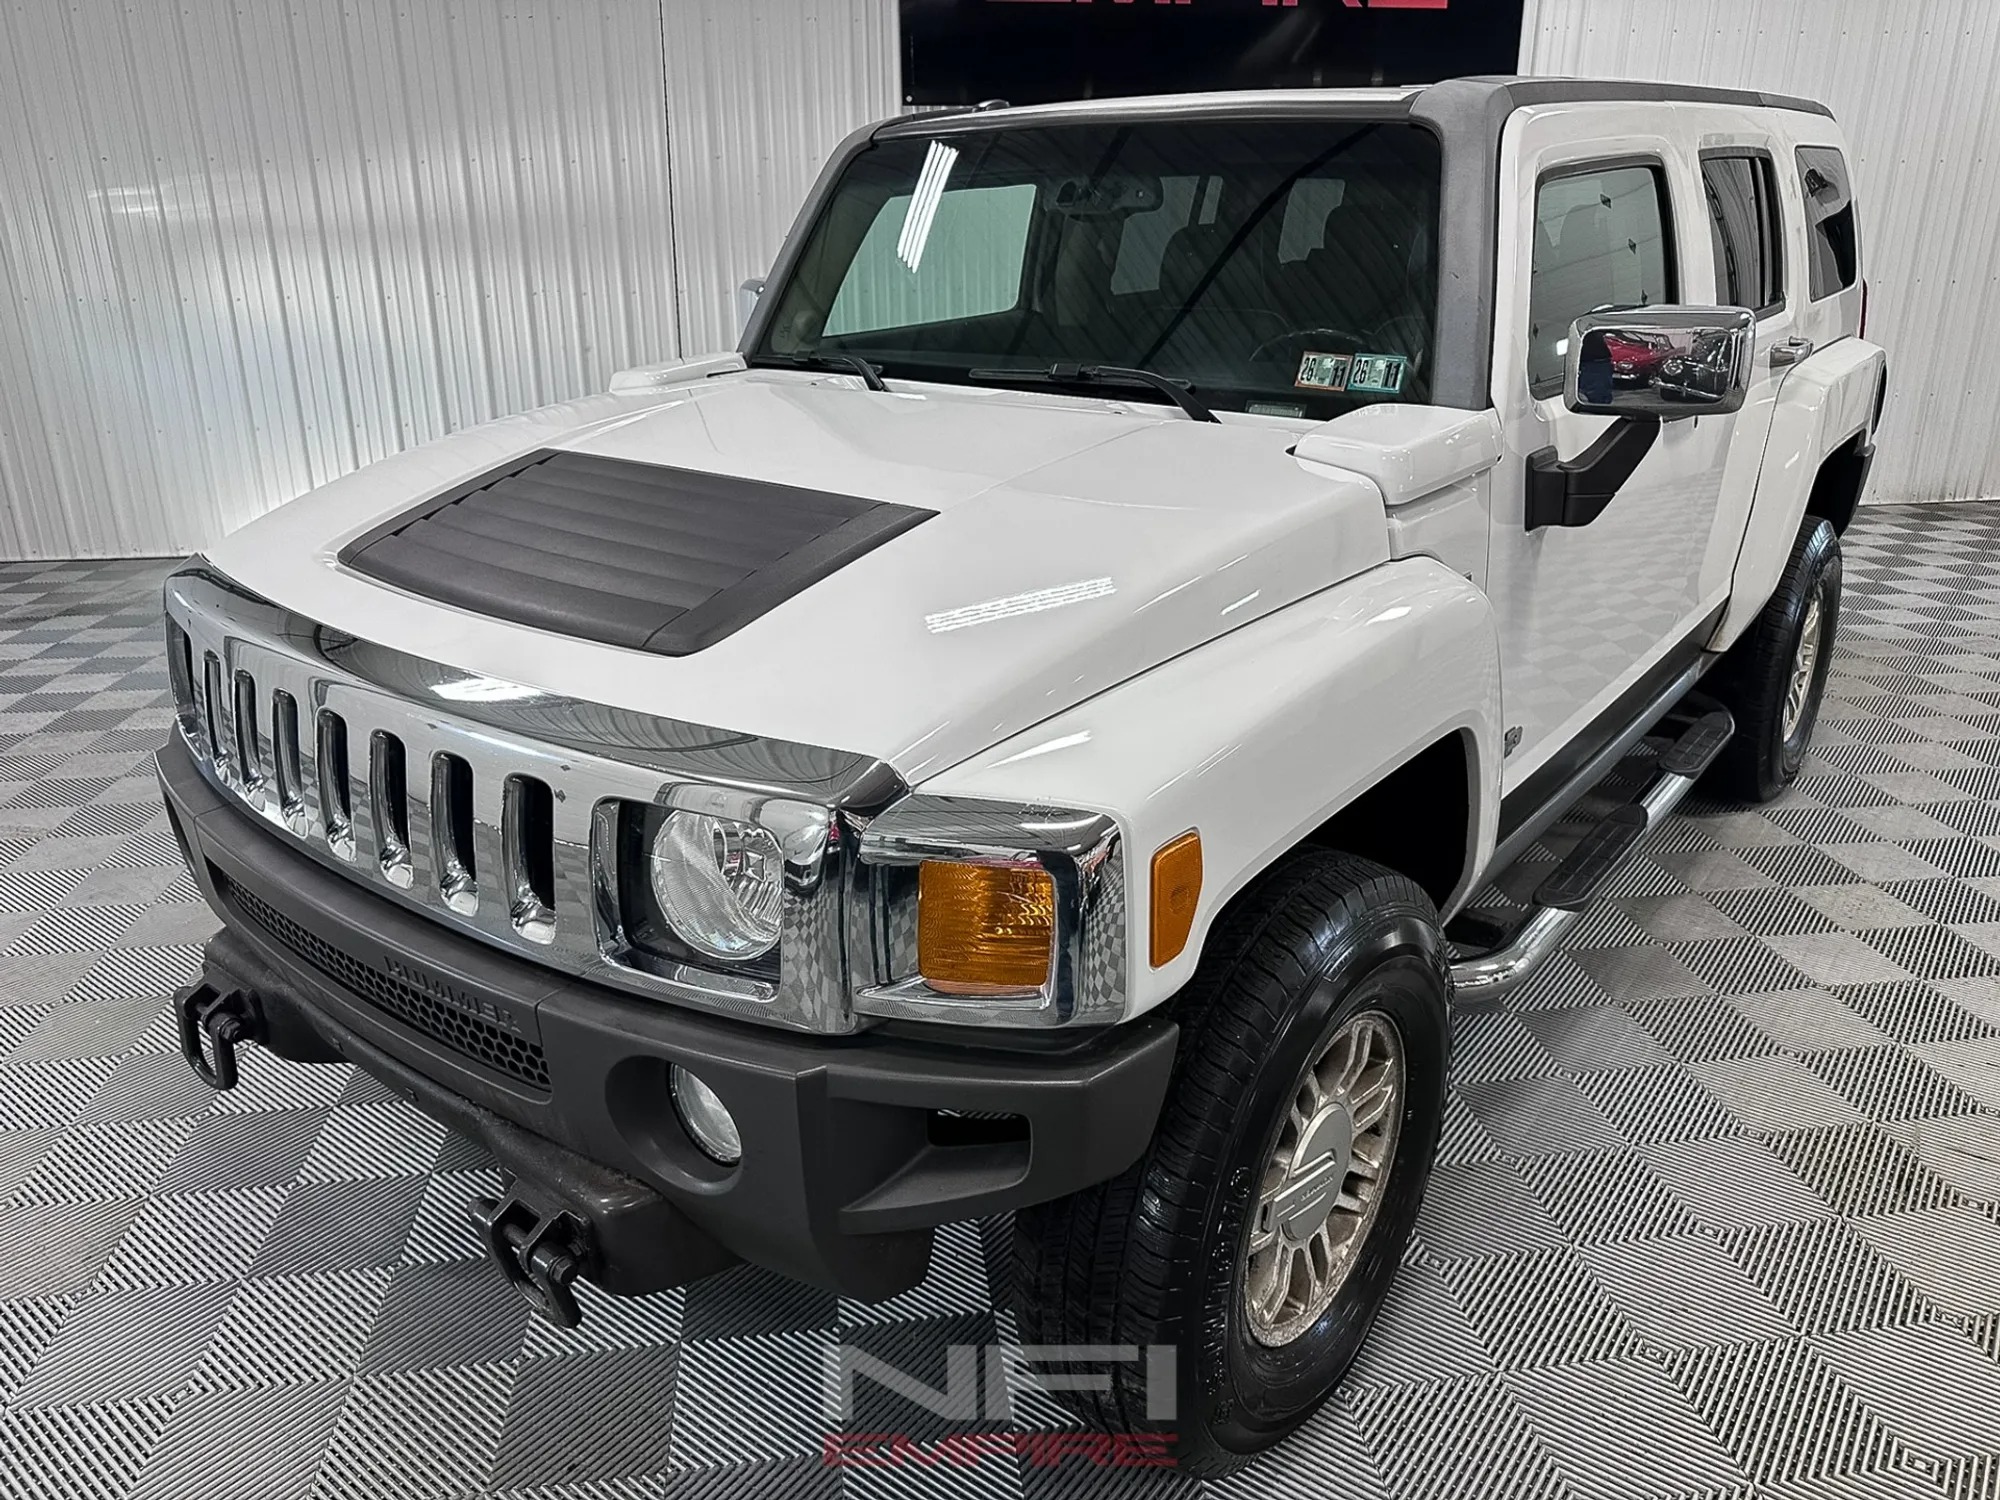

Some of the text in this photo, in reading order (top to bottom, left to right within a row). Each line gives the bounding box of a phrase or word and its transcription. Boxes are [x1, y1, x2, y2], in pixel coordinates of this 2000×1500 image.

[1300, 357, 1347, 388] 26 11
[1353, 359, 1401, 388] 26 11
[383, 955, 523, 1035] HUMMER
